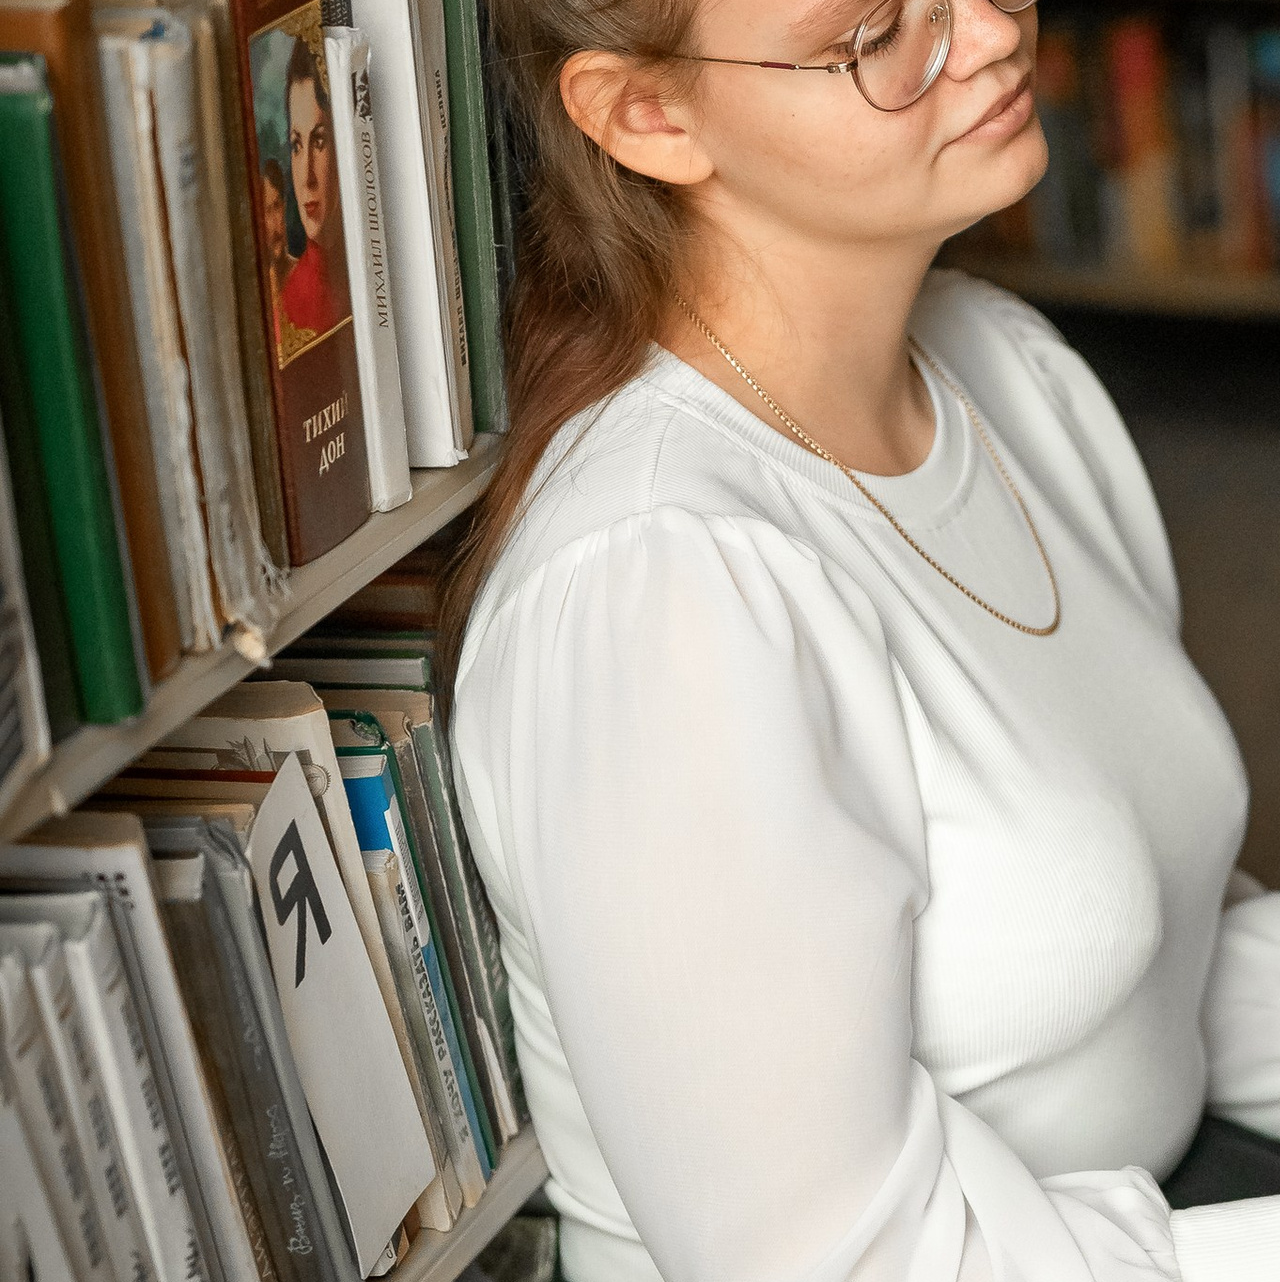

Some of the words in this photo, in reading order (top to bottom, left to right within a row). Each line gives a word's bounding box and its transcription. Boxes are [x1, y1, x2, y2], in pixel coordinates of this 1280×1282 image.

[360, 131, 379, 232] ШОЛОХОВ
[370, 238, 389, 328] МИХАИЛ
[303, 390, 349, 443] ТИХИЙ
[319, 432, 346, 477] ДОН
[268, 818, 332, 989] Я
[412, 937, 448, 1063] РАССКАЗАТЬ
